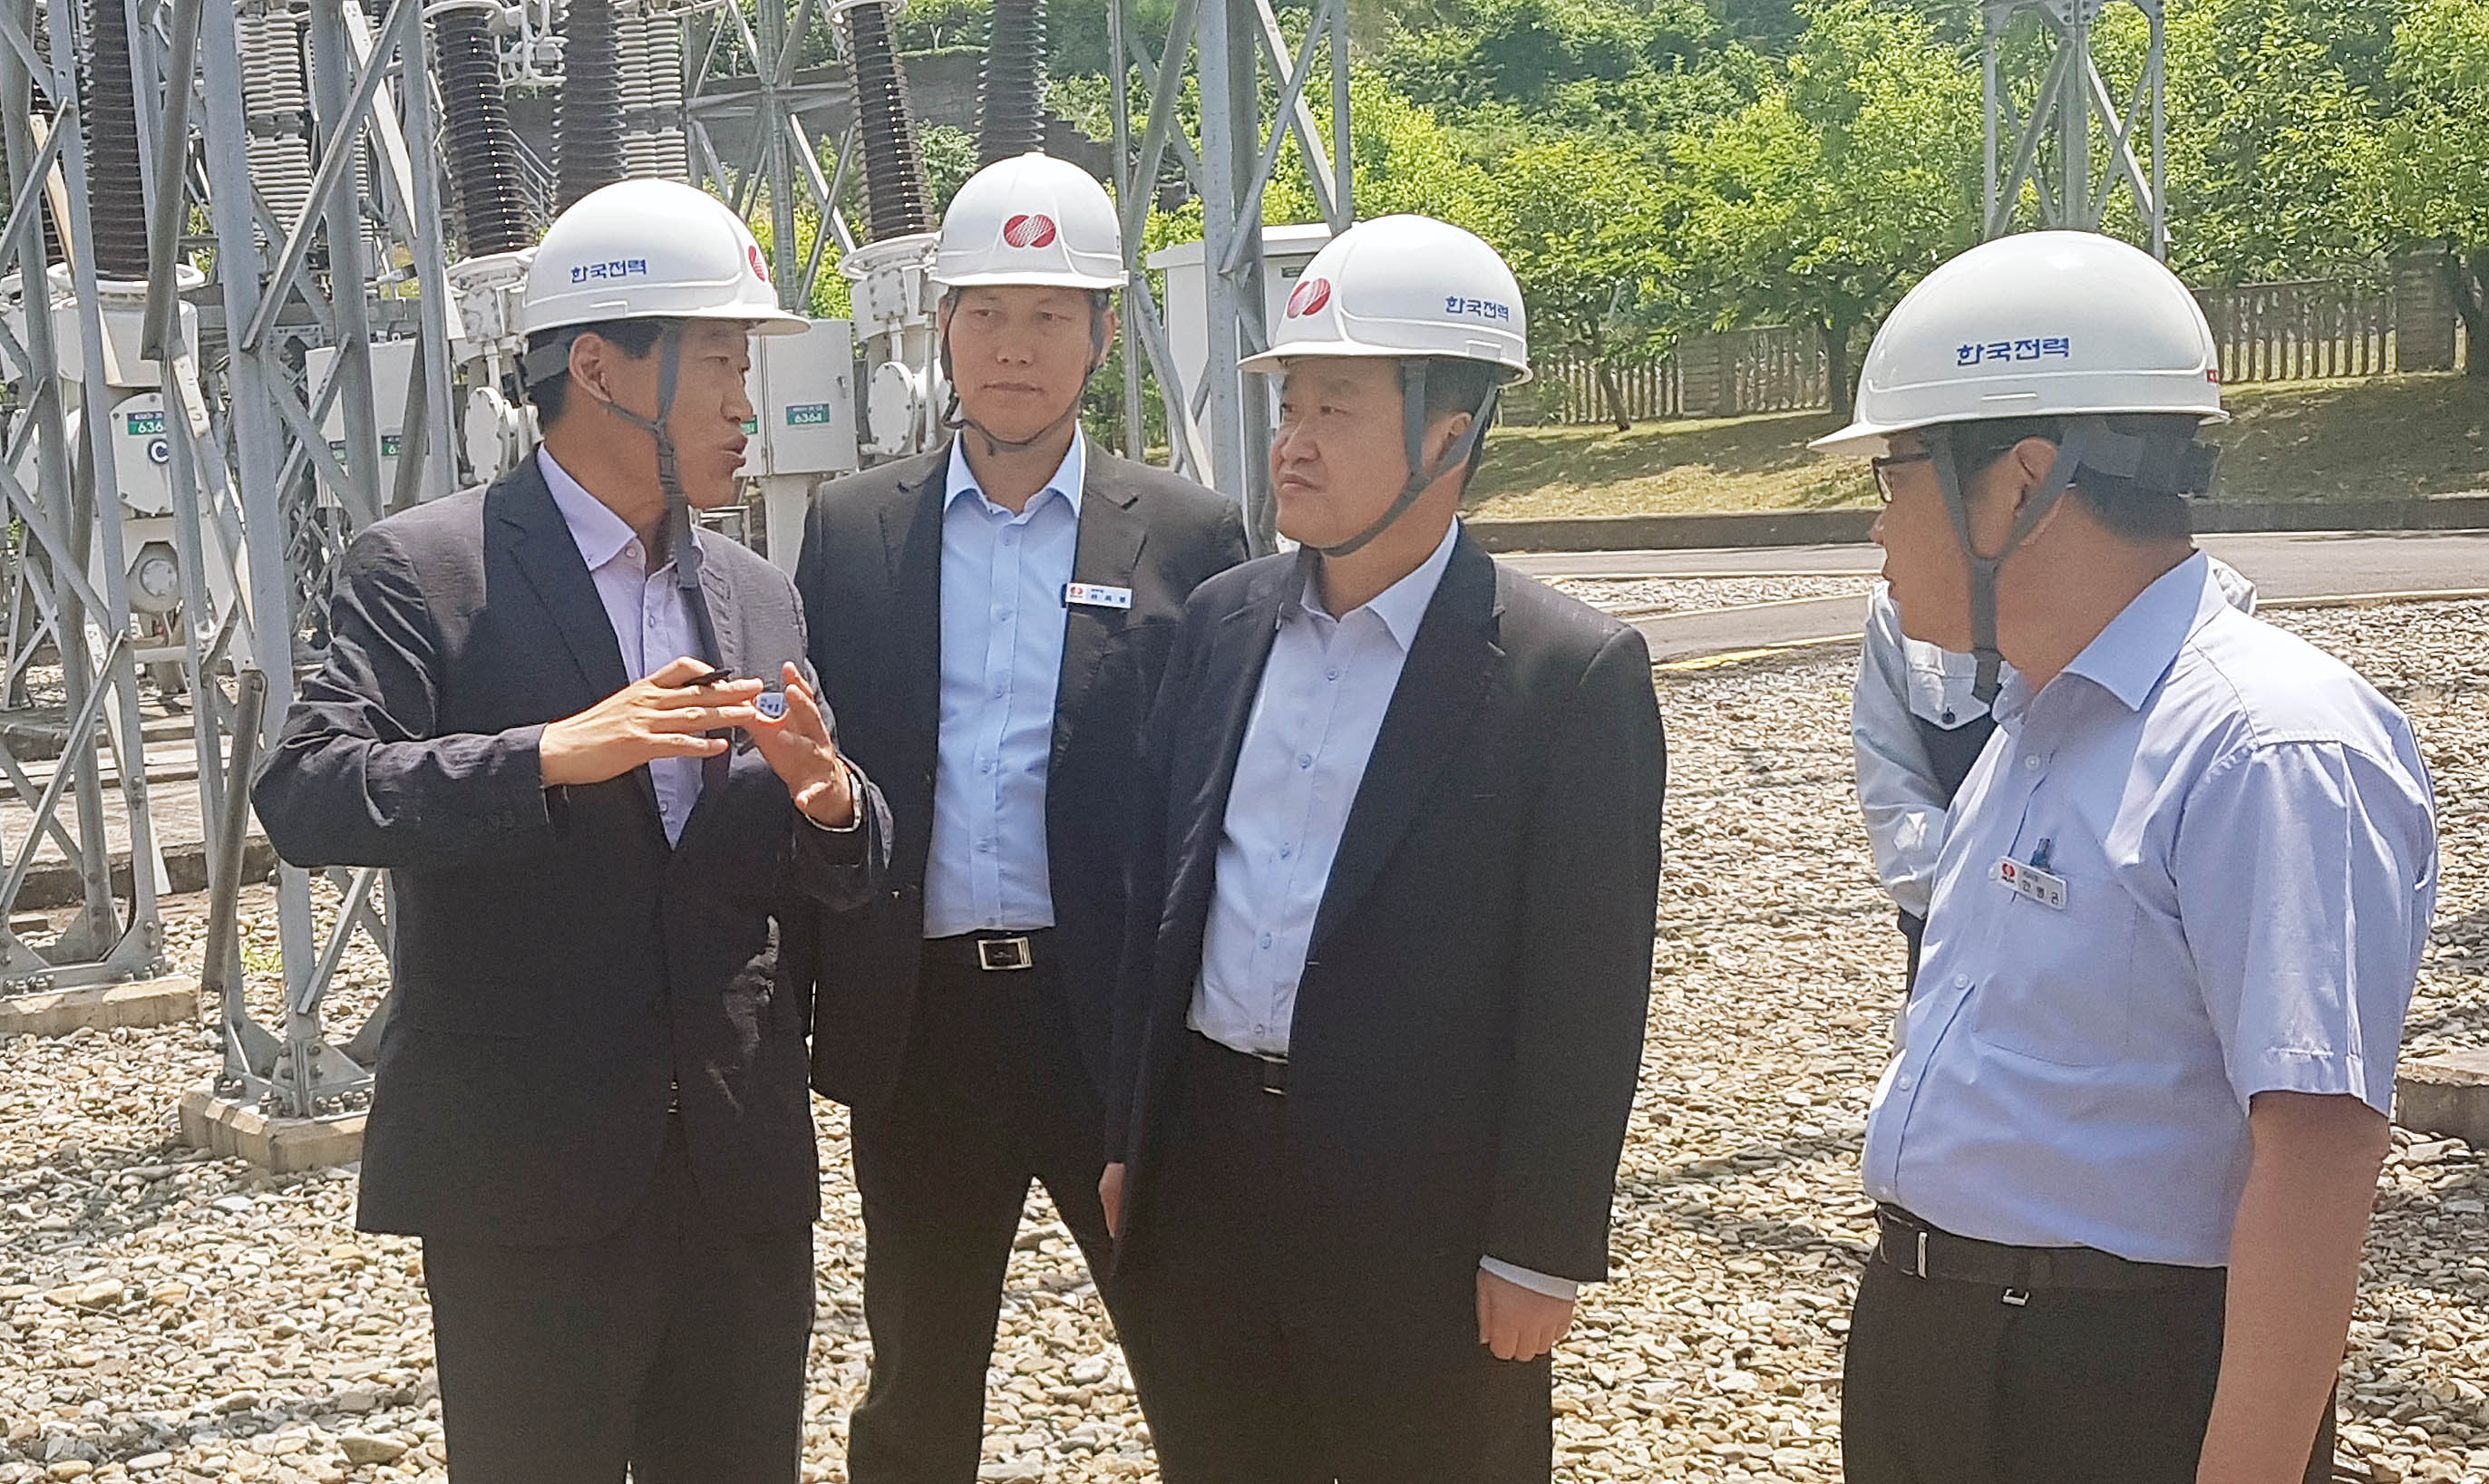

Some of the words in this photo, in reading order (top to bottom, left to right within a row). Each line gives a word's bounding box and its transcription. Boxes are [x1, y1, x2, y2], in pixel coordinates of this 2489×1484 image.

[571, 259, 647, 283] 한국전력
[1445, 296, 1509, 323] 한국전력
[1957, 337, 2069, 366] 한국전력
[138, 422, 167, 433] 636
